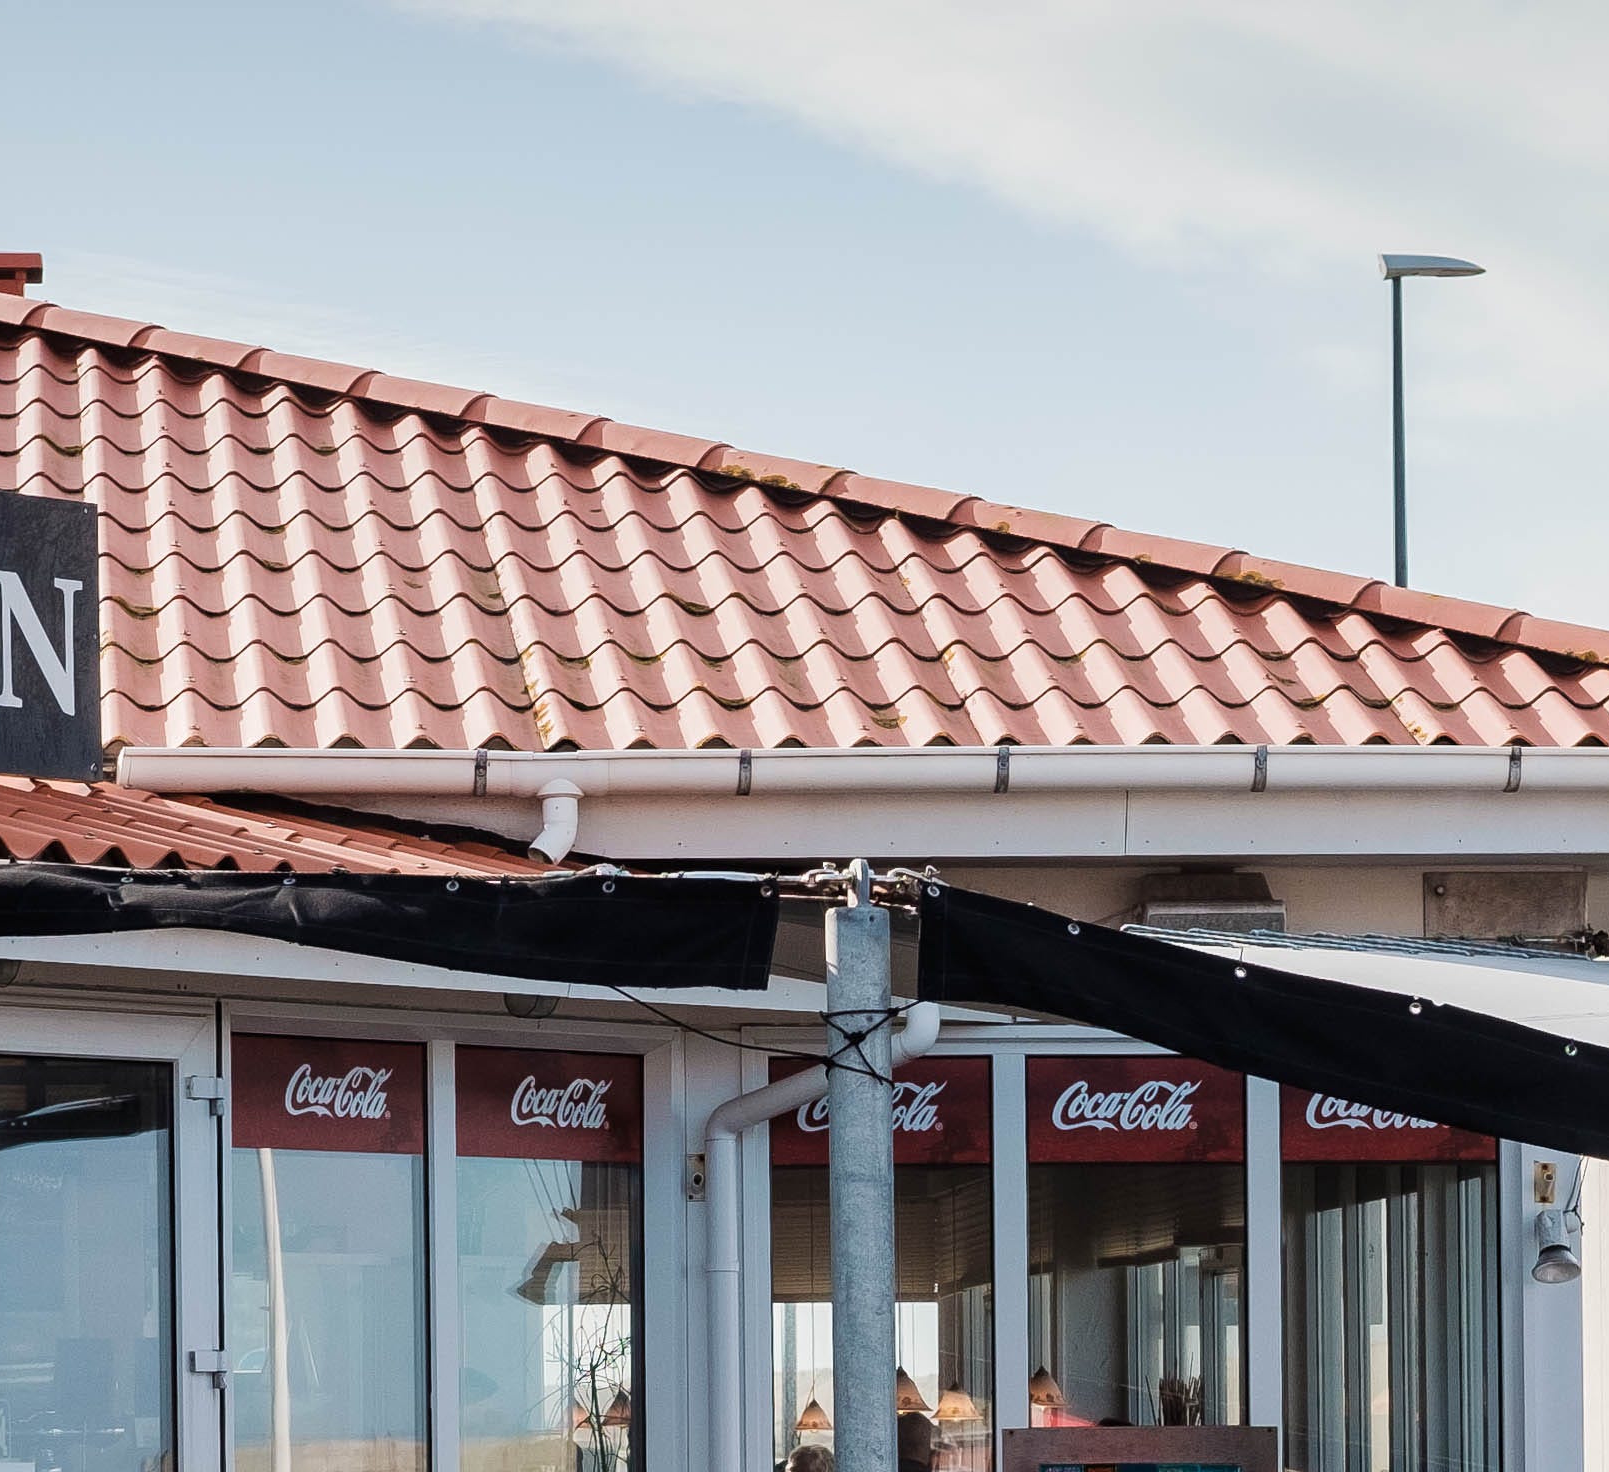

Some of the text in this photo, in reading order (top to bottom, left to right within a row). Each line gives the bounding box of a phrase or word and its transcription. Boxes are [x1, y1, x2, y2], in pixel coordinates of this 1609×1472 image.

[285, 1063, 393, 1120] Coca-Cola
[511, 1075, 613, 1130] Coca-Cola
[1051, 1079, 1203, 1132] Coca-Cola
